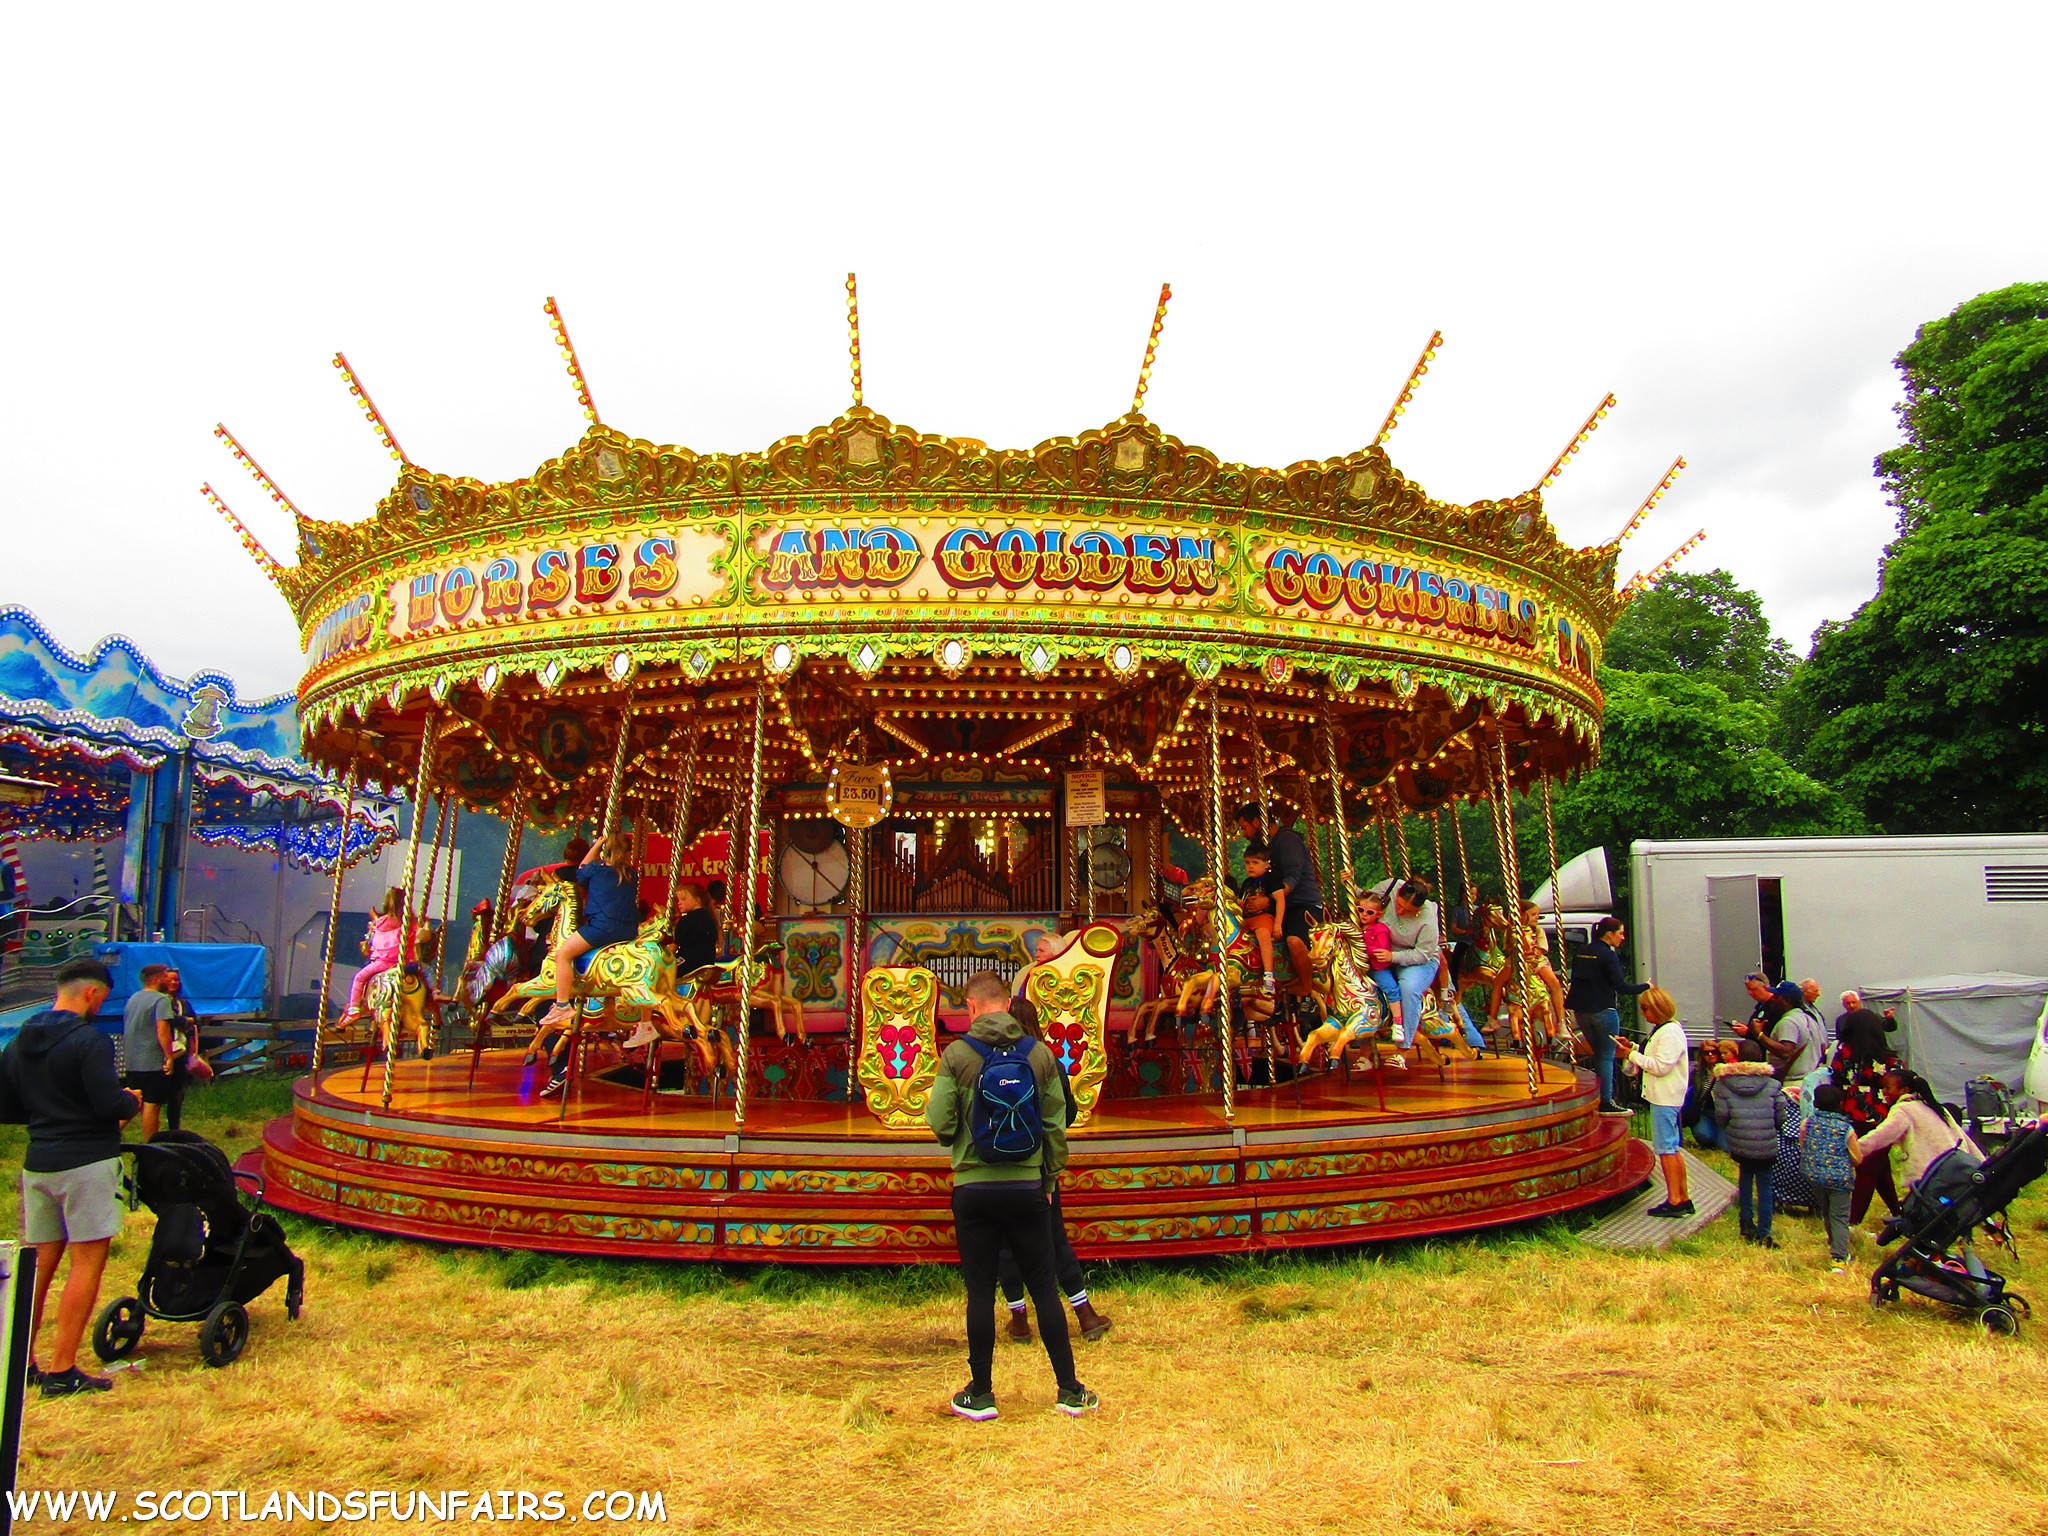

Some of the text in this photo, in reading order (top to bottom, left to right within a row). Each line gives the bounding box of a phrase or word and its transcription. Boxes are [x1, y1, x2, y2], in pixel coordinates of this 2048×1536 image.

[408, 537, 679, 630] HORSES
[763, 528, 1218, 596] AND GOLDEN
[1265, 548, 1538, 649] COCKERELS
[843, 771, 875, 783] Fare
[843, 787, 876, 800] £3.50
